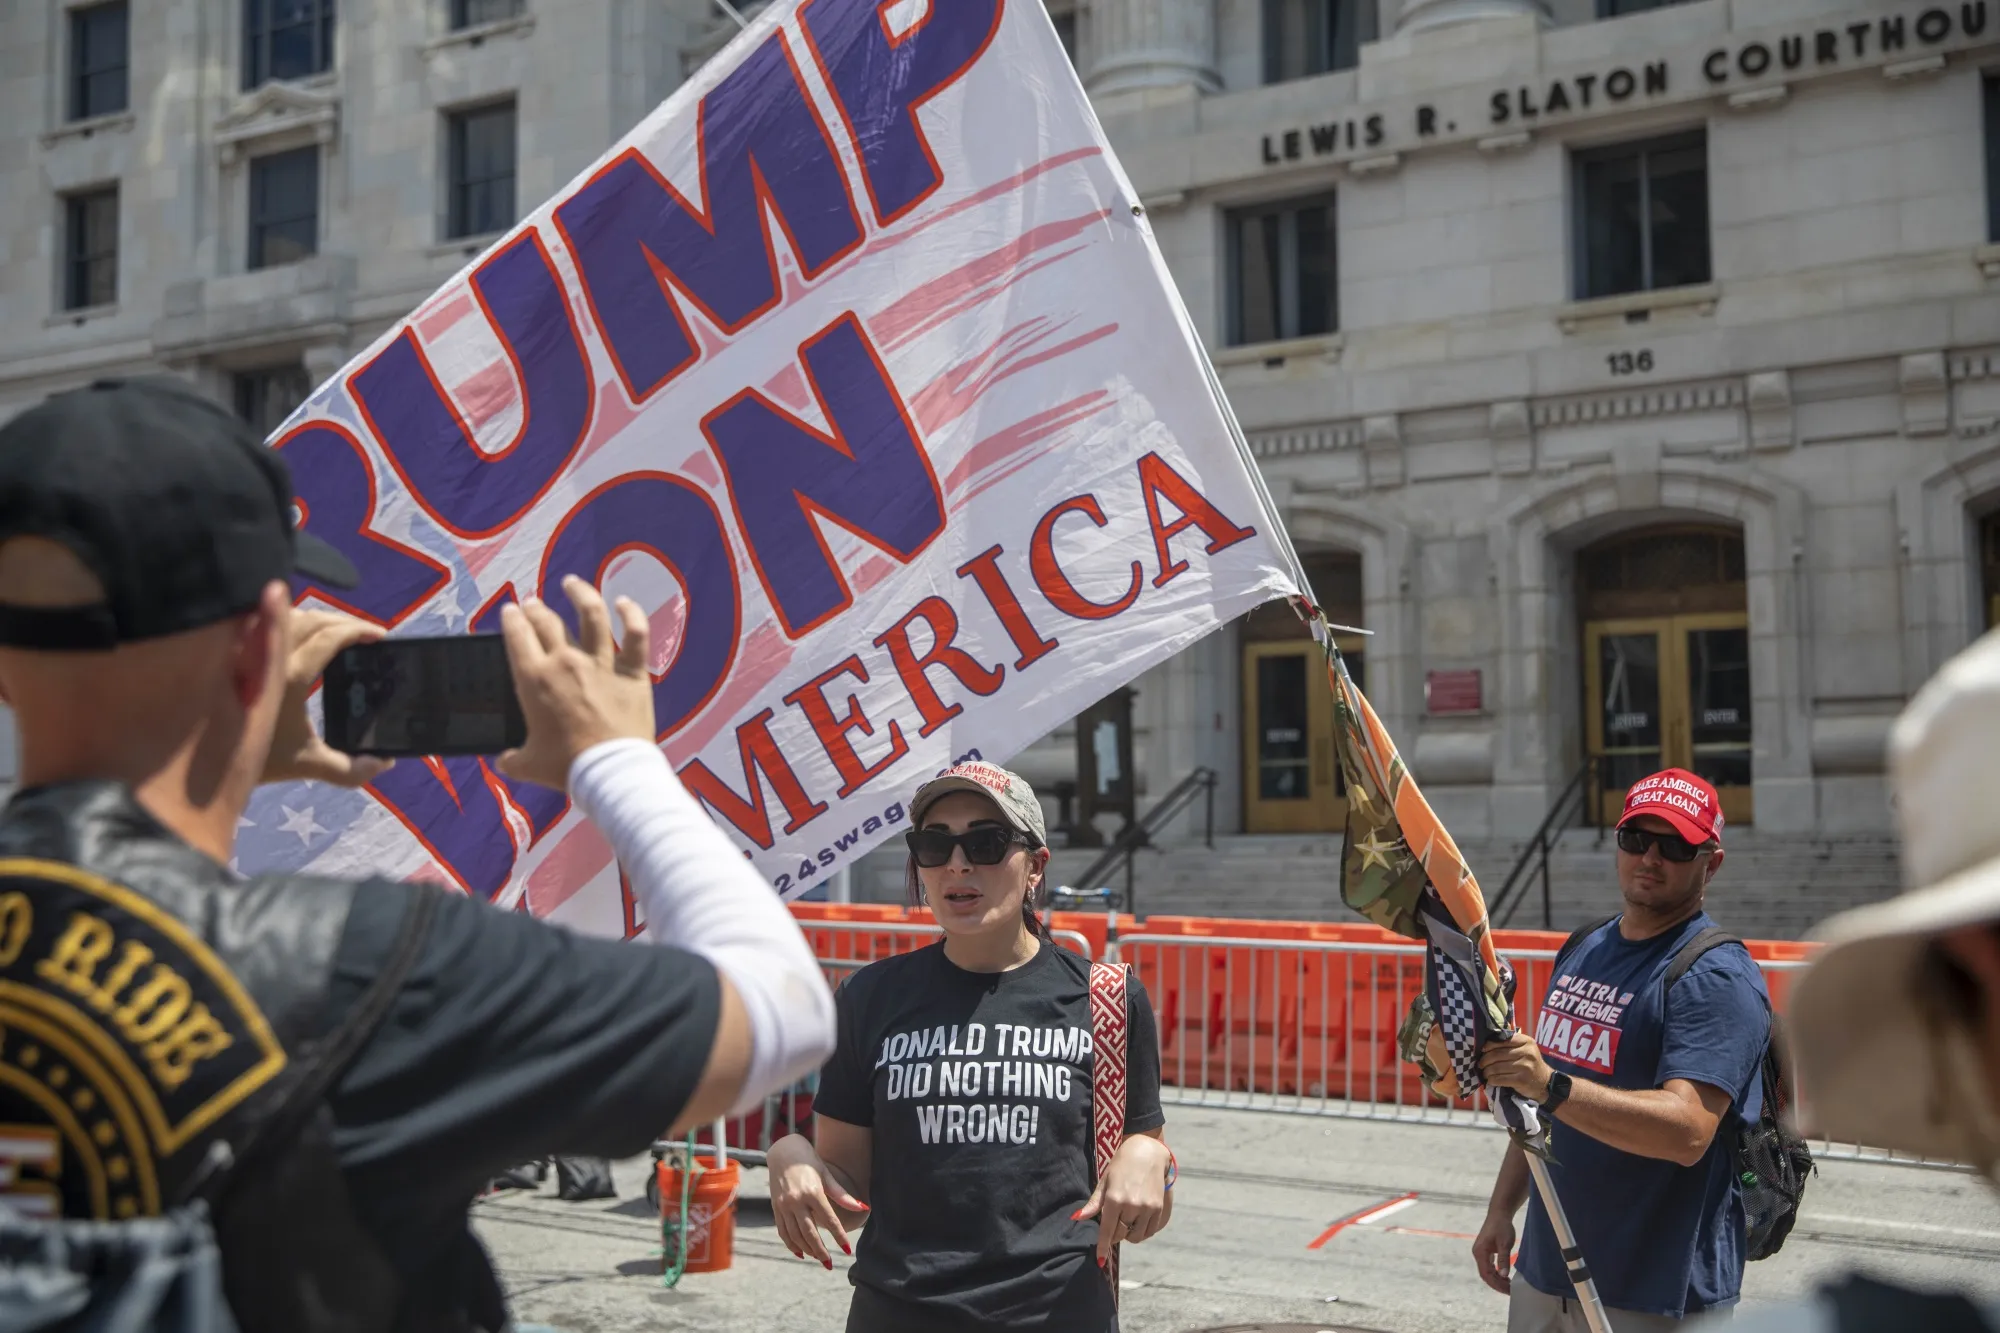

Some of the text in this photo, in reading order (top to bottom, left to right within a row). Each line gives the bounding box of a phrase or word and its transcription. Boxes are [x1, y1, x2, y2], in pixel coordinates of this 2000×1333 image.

[1261, 2, 1987, 165] LEWIS R. SLATON COURTHOU
[266, 0, 1002, 632] RUMP
[1606, 349, 1653, 375] 136
[964, 764, 1012, 788] AMERICA
[972, 775, 1005, 794] AGAIN
[1630, 777, 1709, 808] MAKE AMERICA
[1631, 791, 1701, 818] GREAT AGAIN
[35, 911, 234, 1094] RIDE
[1548, 990, 1623, 1025] EXTREME
[1568, 976, 1618, 1003] ULTRA
[995, 1023, 1093, 1065] TRUMP
[1534, 1010, 1611, 1067] MAGA
[887, 1061, 1071, 1102] DID NOTHING
[916, 1104, 1040, 1145] WRONG!
